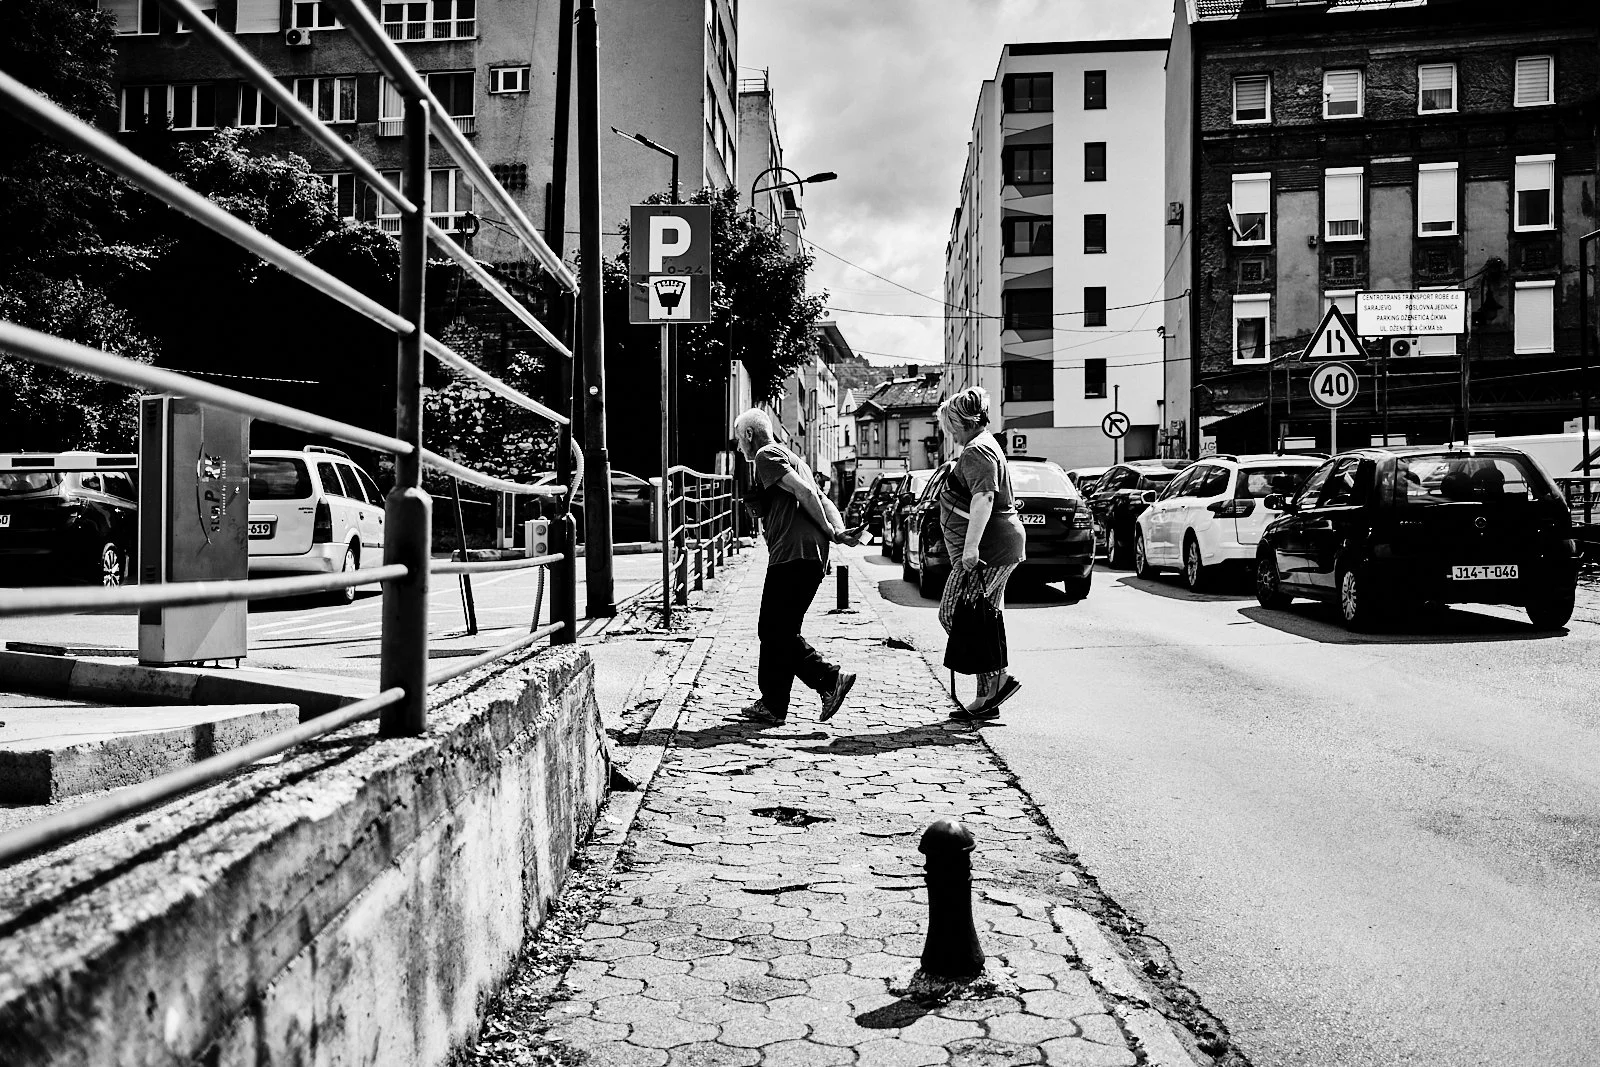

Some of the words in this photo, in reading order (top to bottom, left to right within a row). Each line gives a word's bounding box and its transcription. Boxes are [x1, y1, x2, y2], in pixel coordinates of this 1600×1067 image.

[648, 215, 692, 273] P
[667, 265, 704, 275] 0-24
[1320, 373, 1349, 396] 40
[1015, 436, 1024, 448] P
[1455, 565, 1517, 579] J14-T-046
